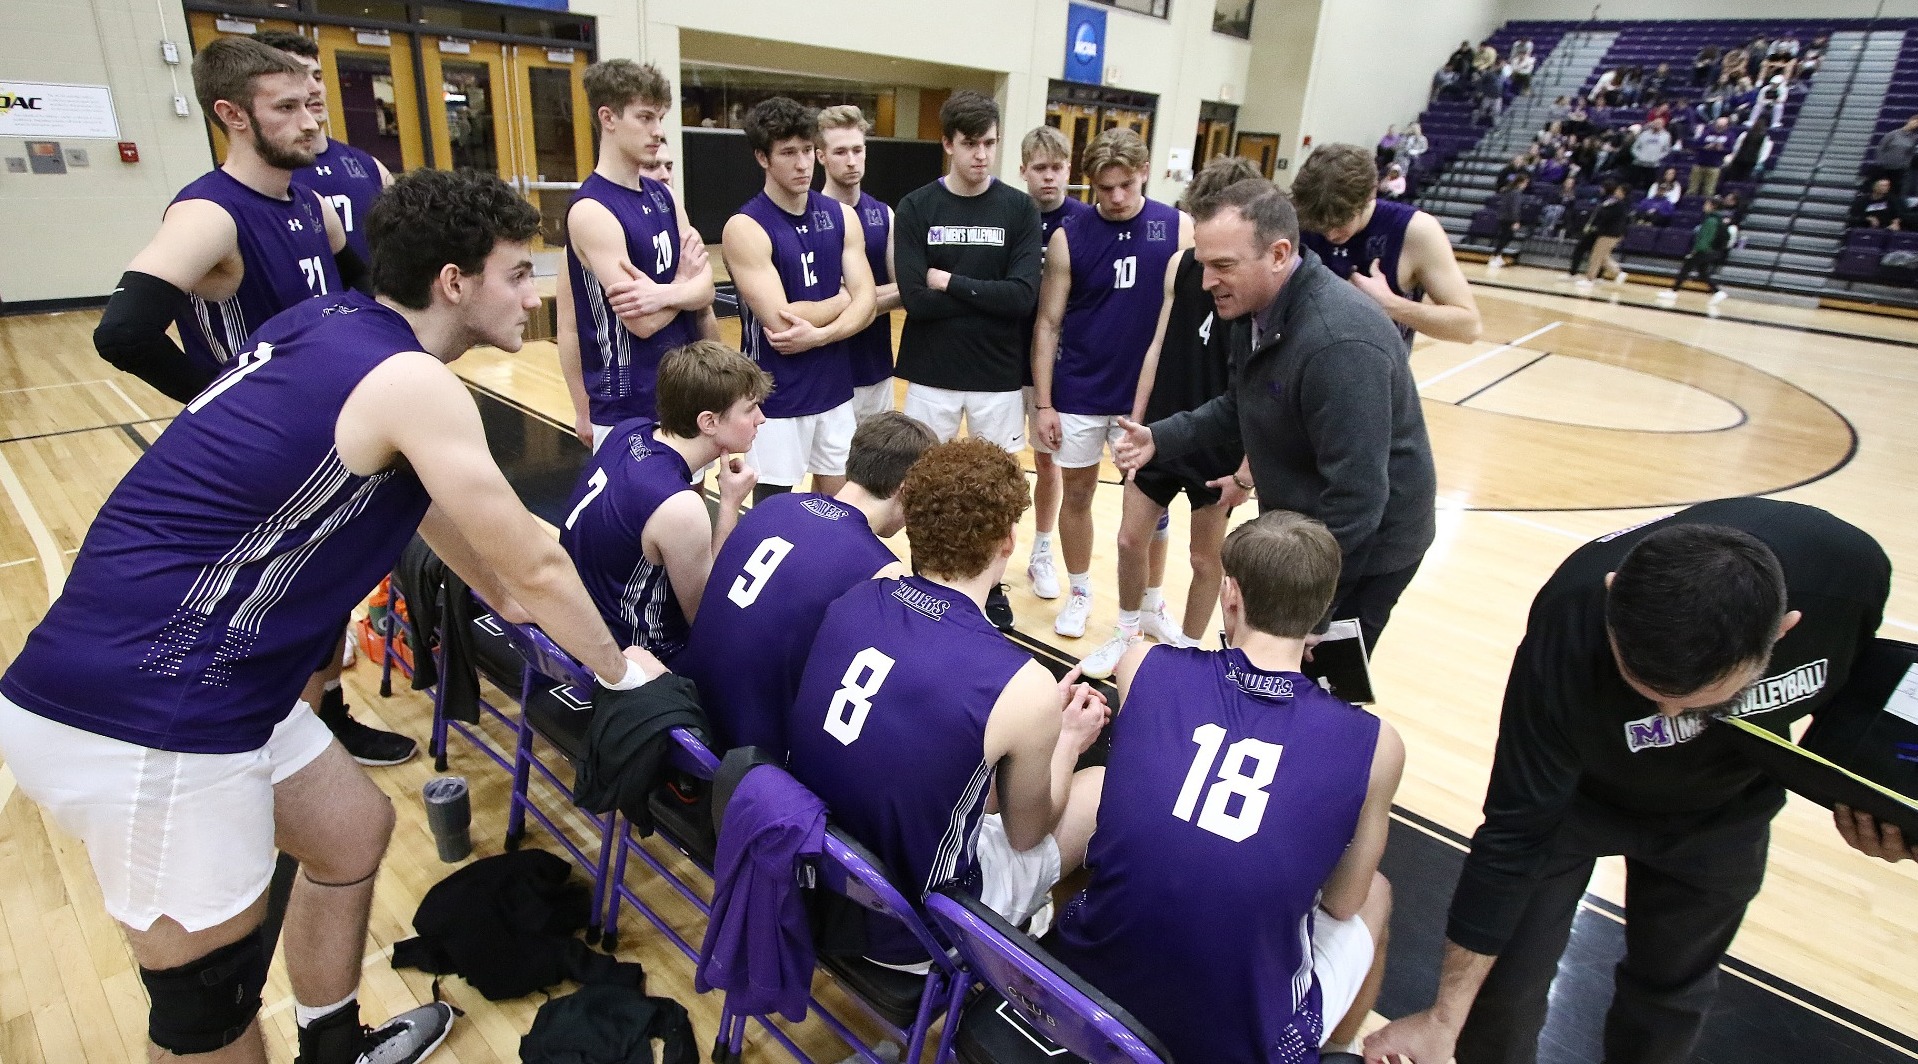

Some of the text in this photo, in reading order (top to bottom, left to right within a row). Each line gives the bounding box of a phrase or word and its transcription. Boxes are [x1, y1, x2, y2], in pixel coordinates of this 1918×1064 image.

[323, 194, 354, 232] 7
[1146, 220, 1167, 242] M
[652, 230, 673, 275] 20
[967, 228, 1004, 245] VOLLEYBALL
[800, 251, 818, 287] 12
[1112, 256, 1137, 289] 10
[1198, 310, 1214, 346] 4
[564, 466, 608, 531] 7
[726, 535, 795, 609] 9
[822, 646, 896, 747] 8
[1630, 718, 1670, 746] M
[1171, 722, 1284, 843] 18
